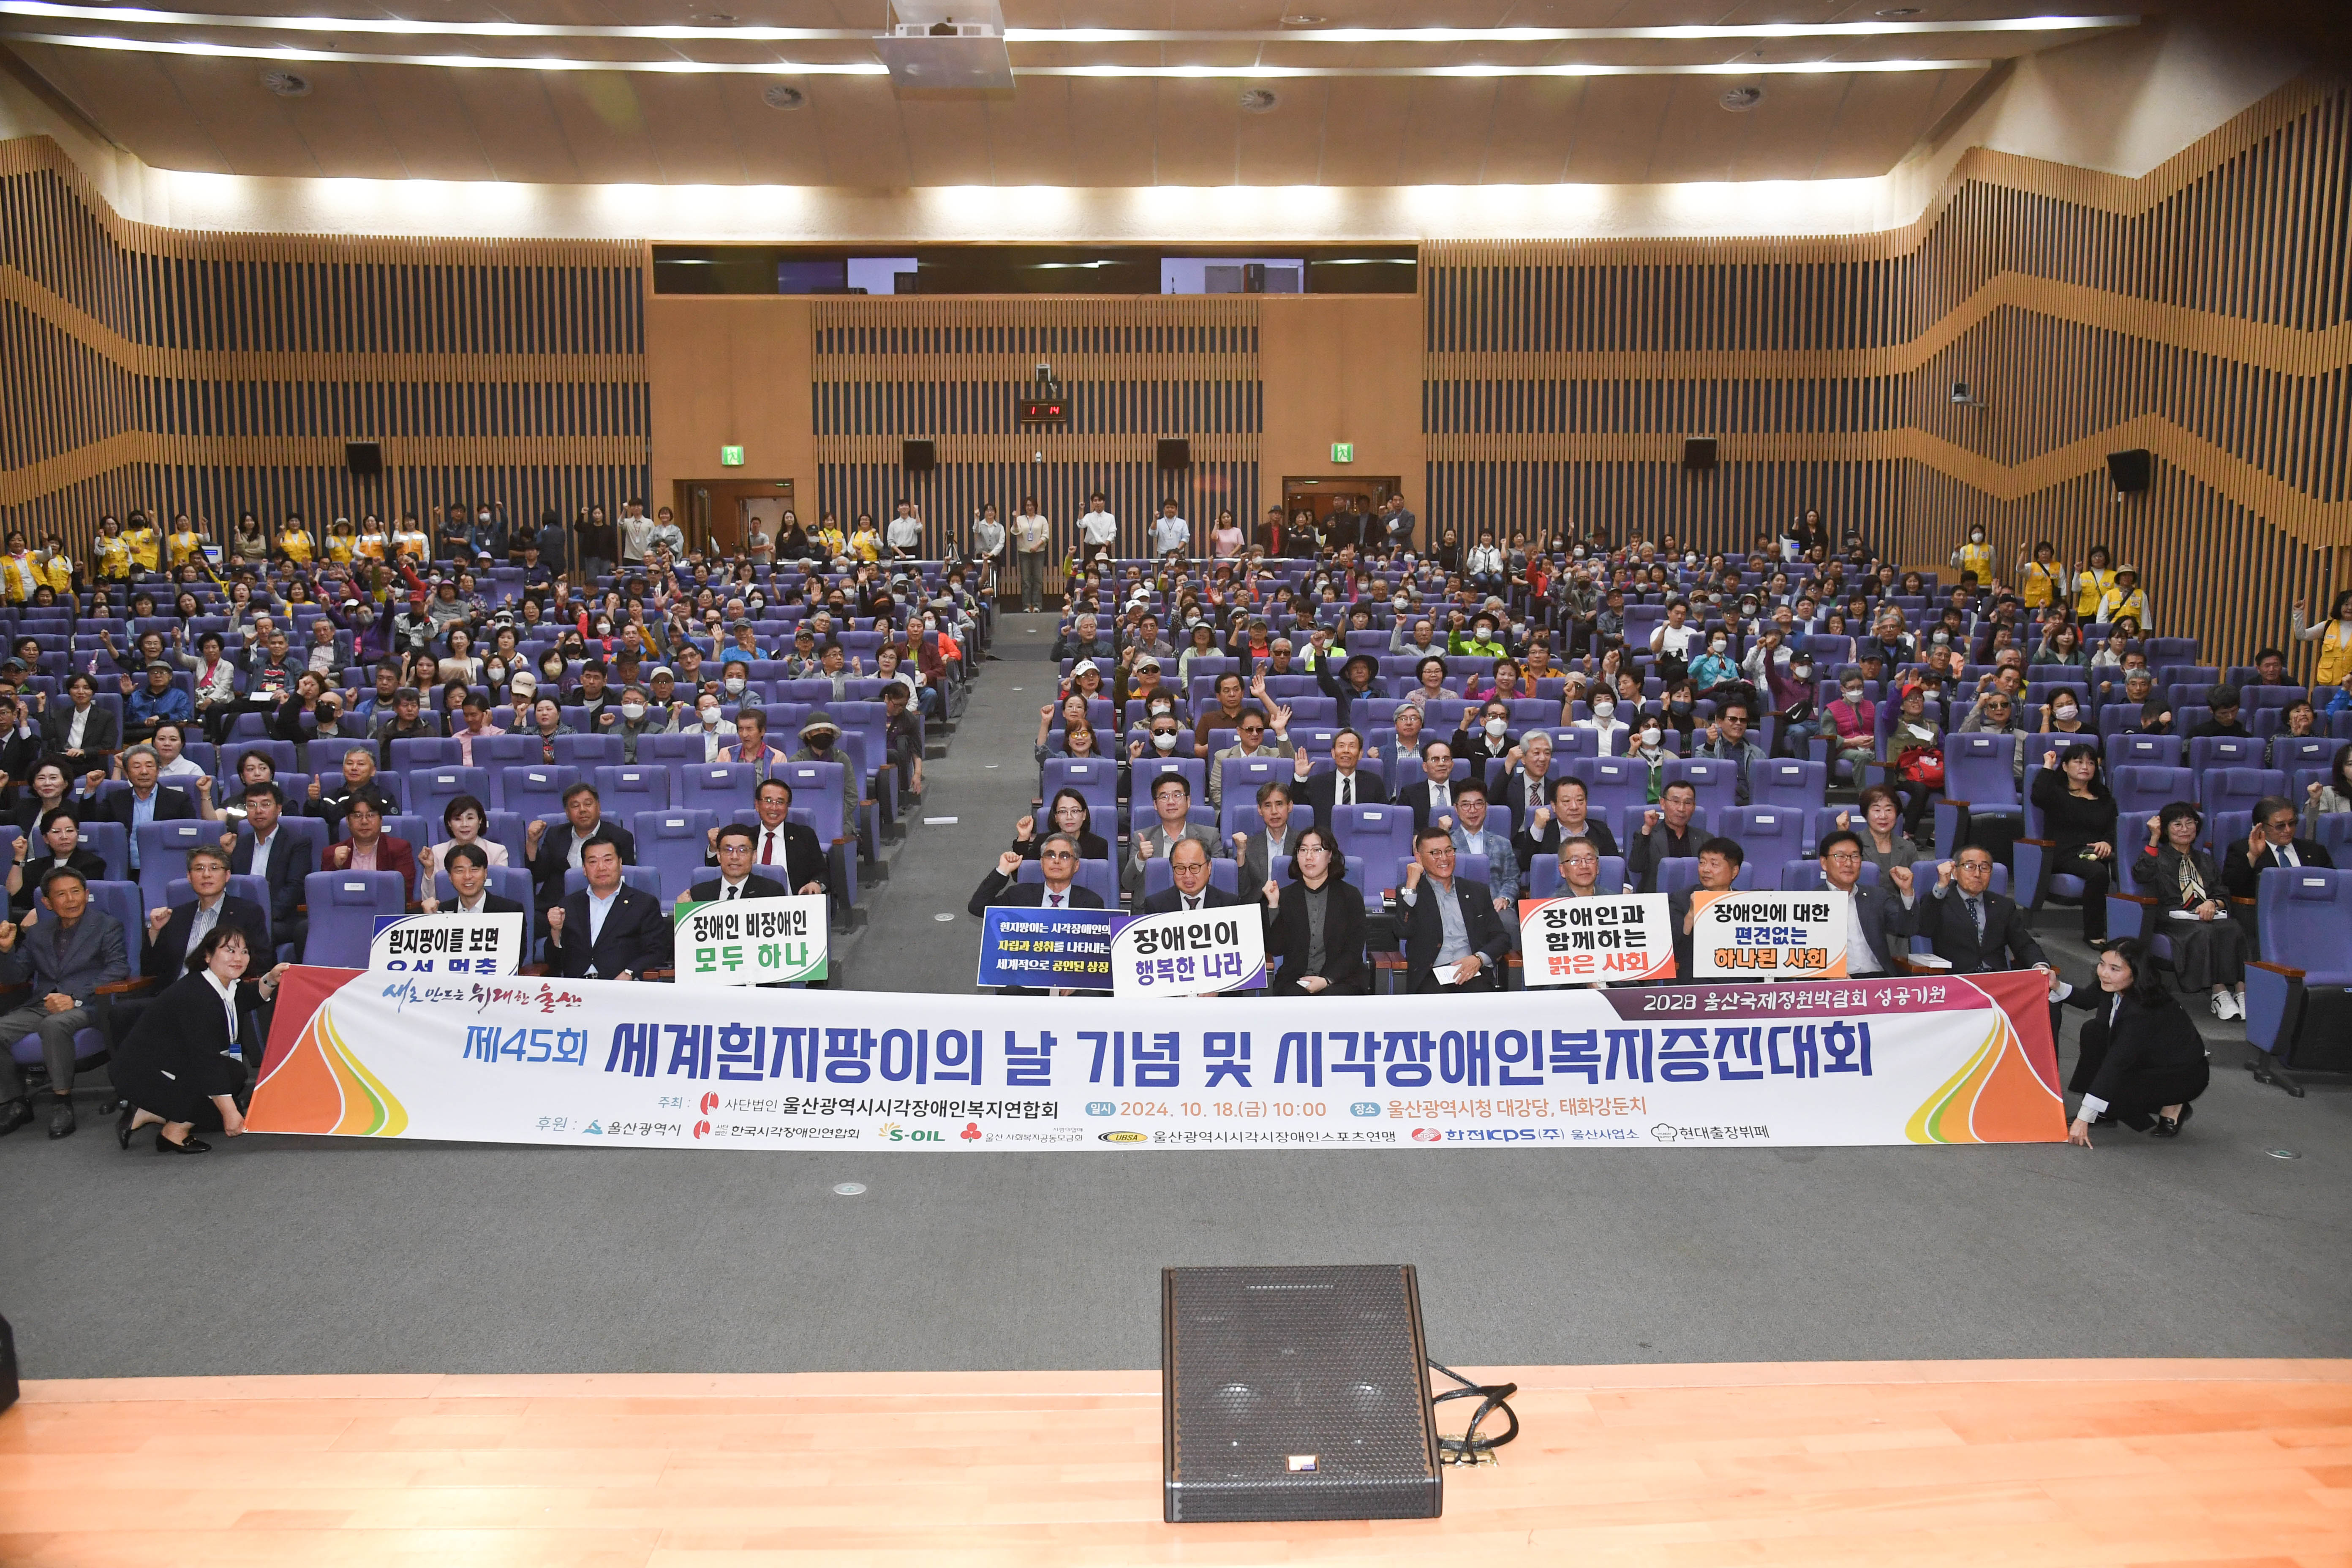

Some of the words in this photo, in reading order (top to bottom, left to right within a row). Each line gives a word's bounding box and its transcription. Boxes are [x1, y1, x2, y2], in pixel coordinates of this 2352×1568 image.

[1543, 905, 1645, 928] 장애인과
[1714, 904, 1786, 923] 장애인에
[1794, 904, 1829, 922] 대한
[693, 914, 739, 942] 장애인
[746, 910, 806, 938] 비장애인
[999, 922, 1049, 933] 흰지팡이는
[1051, 923, 1111, 935] 시각장애인의
[1735, 927, 1807, 945] 편견없는
[389, 928, 464, 954] 흰지팡이를
[469, 928, 499, 952] 보면
[997, 939, 1030, 952] 자립과
[1033, 941, 1064, 953] 성취를
[1067, 942, 1111, 954] 나타내는
[1133, 920, 1239, 954] 장애인이
[1545, 929, 1647, 953] 함께하는
[695, 946, 743, 972] 모두
[758, 942, 808, 969] 하나
[996, 958, 1049, 971] 세계적으로
[1052, 960, 1084, 972] 공인된
[1087, 961, 1109, 973] 상징
[1548, 955, 1595, 975] 밝은
[1602, 952, 1649, 972] 사회
[1714, 947, 1778, 969] 하나된
[1784, 947, 1827, 969] 사회
[1136, 956, 1195, 985] 행복한
[1203, 952, 1243, 978] 나라
[382, 977, 424, 1013] 새로
[425, 987, 463, 1002] 만드는
[468, 983, 529, 1014] 위대한
[534, 983, 582, 1013] 울산
[1643, 994, 1697, 1011] 2028
[1703, 989, 1868, 1012] 울산국제정원박람회
[1874, 986, 1946, 1005] 성공기원
[463, 1026, 588, 1066] 제45회
[604, 1022, 983, 1085] 세계흰지팡이의
[1005, 1031, 1057, 1086] 날
[1077, 1031, 1179, 1087] 기념
[1203, 1032, 1252, 1087] 및
[1273, 1020, 1872, 1087] 시각장애인복지증진대회
[658, 1097, 683, 1108] 주최
[725, 1099, 777, 1112] 사단법인
[783, 1097, 1058, 1119] 울산광역시시각장애인복지연합회
[1090, 1103, 1112, 1115] 일시
[1121, 1102, 1173, 1116] 2024.
[1181, 1102, 1206, 1116] 10.
[1273, 1102, 1326, 1116] 10:00
[1354, 1104, 1376, 1115] 장소
[1387, 1100, 1491, 1118] 울산광역시청
[1497, 1098, 1554, 1117] 대강당,
[1560, 1097, 1646, 1116] 태화강둔치
[536, 1116, 567, 1131] 후원
[608, 1122, 681, 1136] 울산광역시
[732, 1126, 859, 1139] 한국시각장애인연합회
[889, 1130, 945, 1141] S-OIL
[1571, 1129, 1639, 1140] 울산사업소
[1679, 1125, 1769, 1139] 현대출장뷔페
[985, 1133, 1003, 1142] 울산
[1006, 1134, 1083, 1143] 사회복지공동모금회
